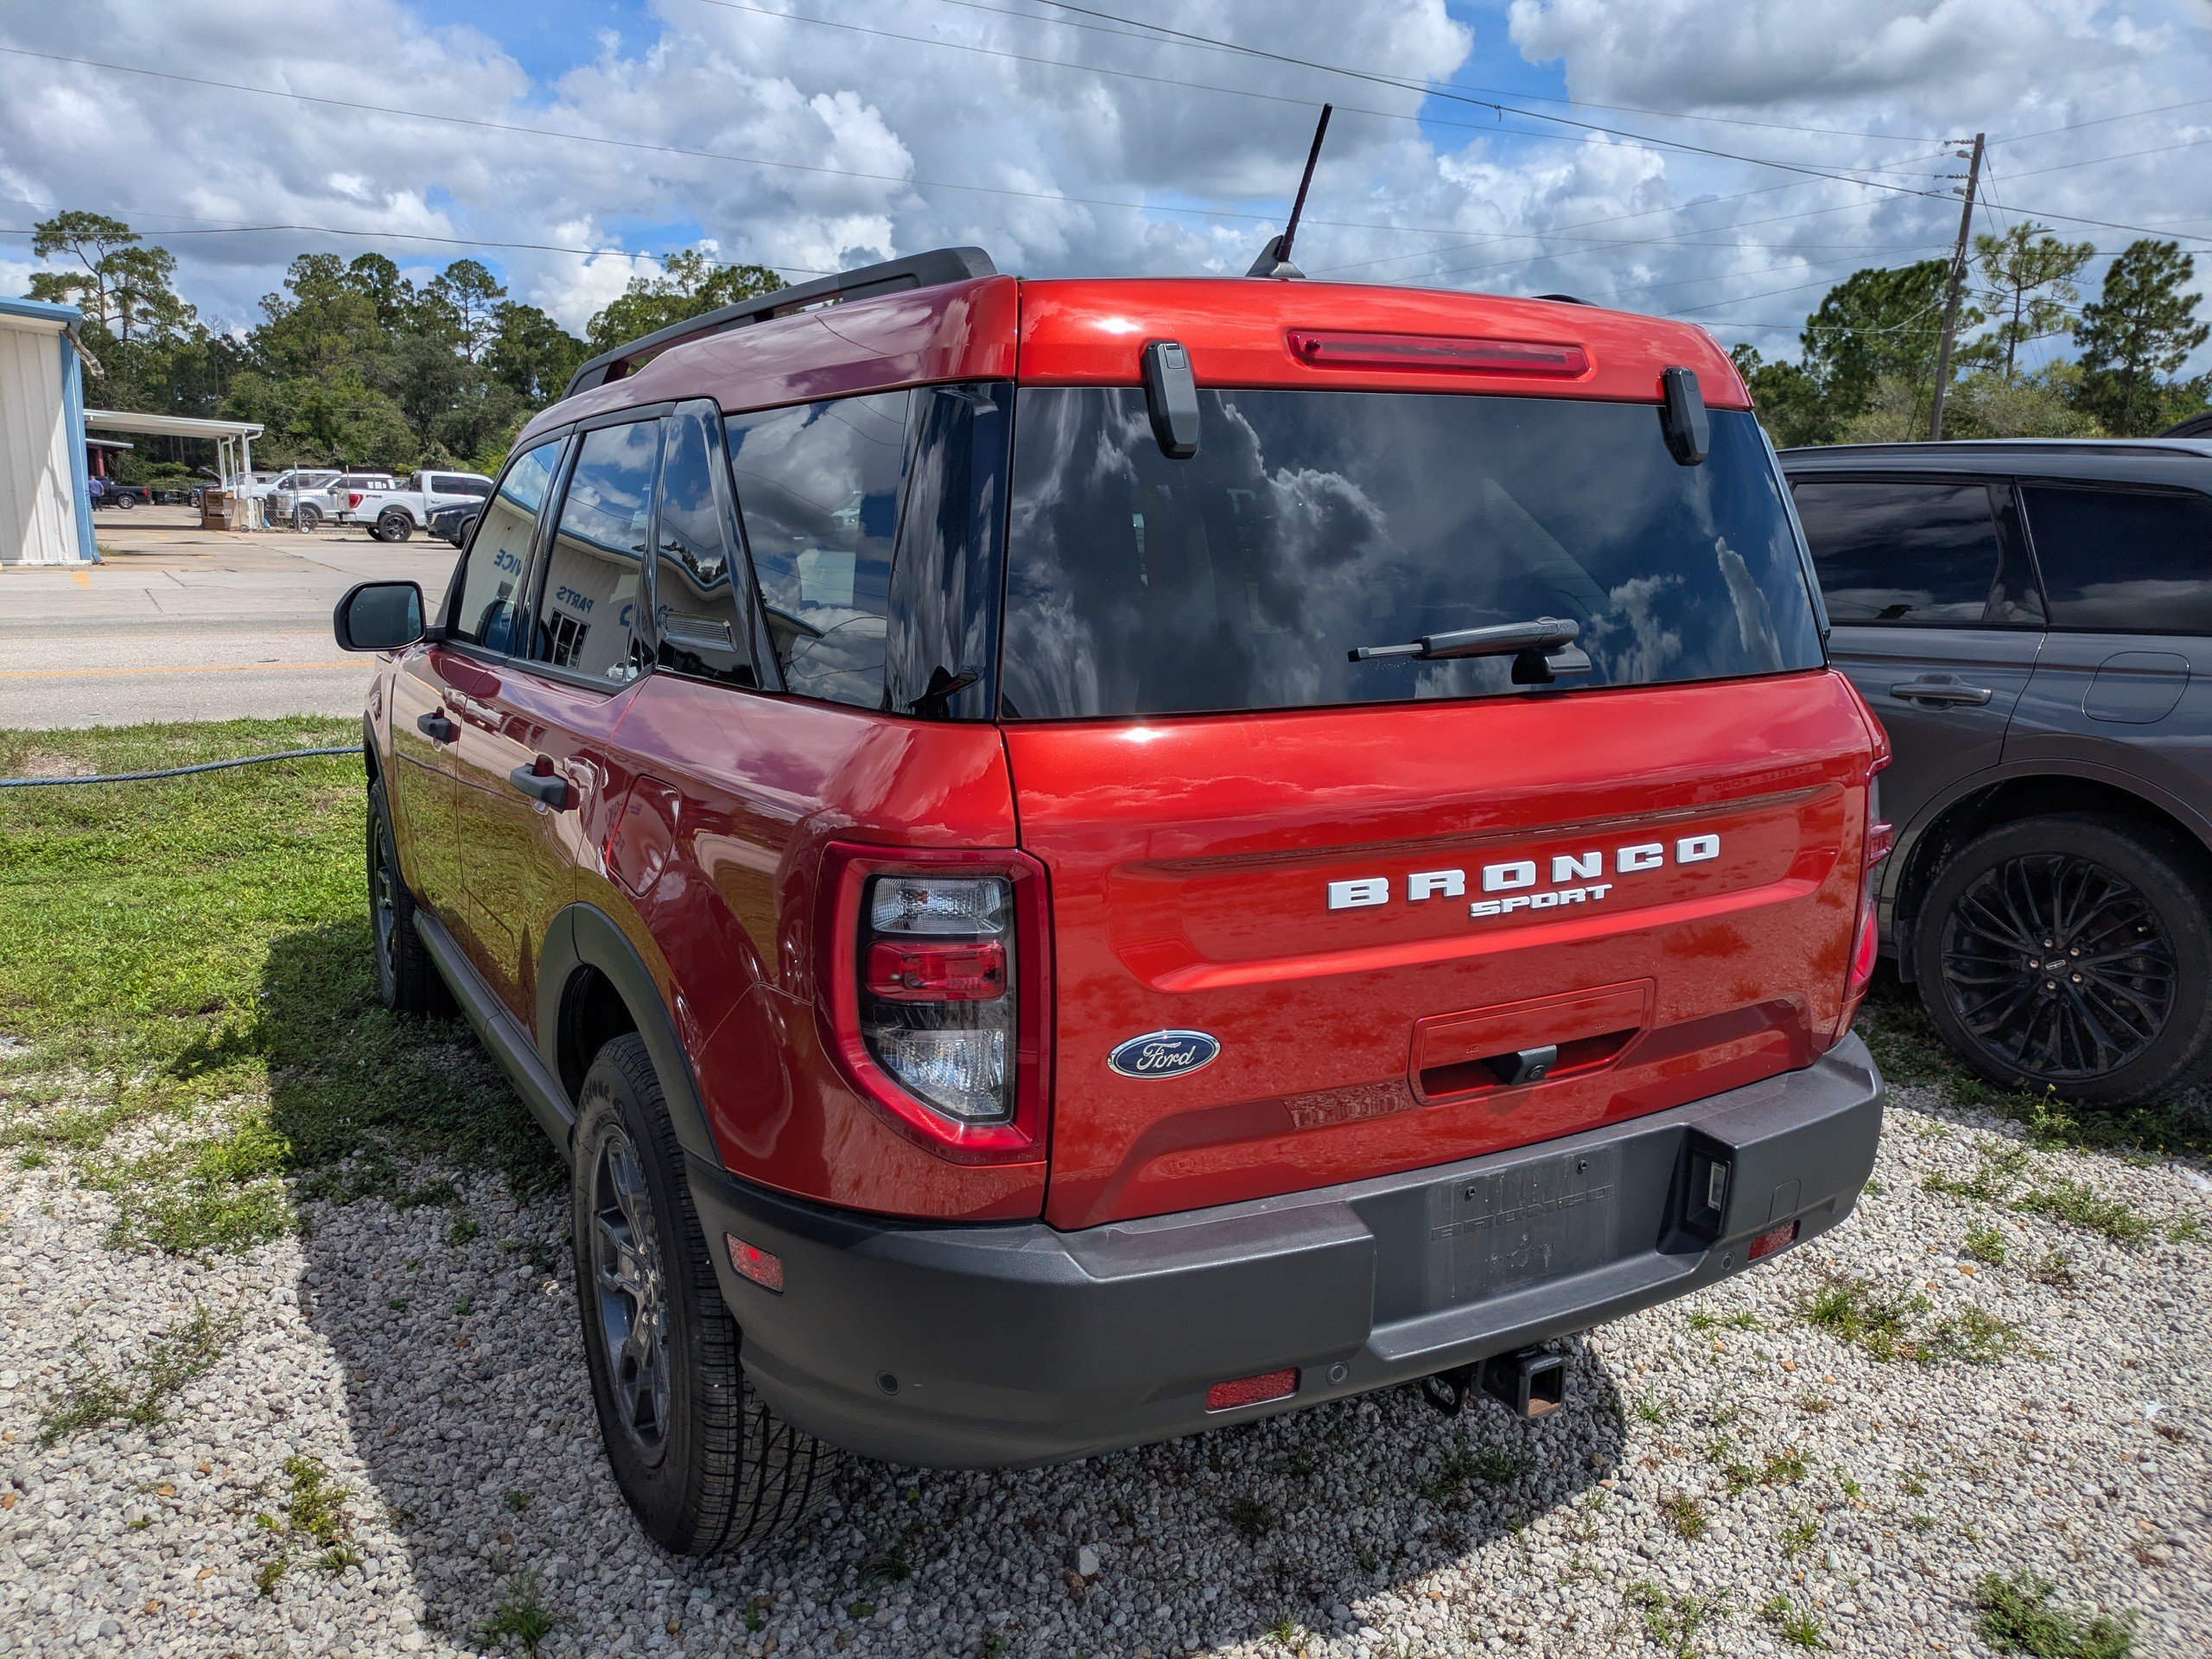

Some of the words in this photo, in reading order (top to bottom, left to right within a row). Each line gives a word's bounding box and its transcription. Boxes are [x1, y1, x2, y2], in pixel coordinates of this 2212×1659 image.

[1327, 834, 1720, 911] BRONCO
[1470, 883, 1613, 918] SPORT
[1136, 1041, 1197, 1071] Ford
[1431, 1185, 1614, 1241] BRONCO
